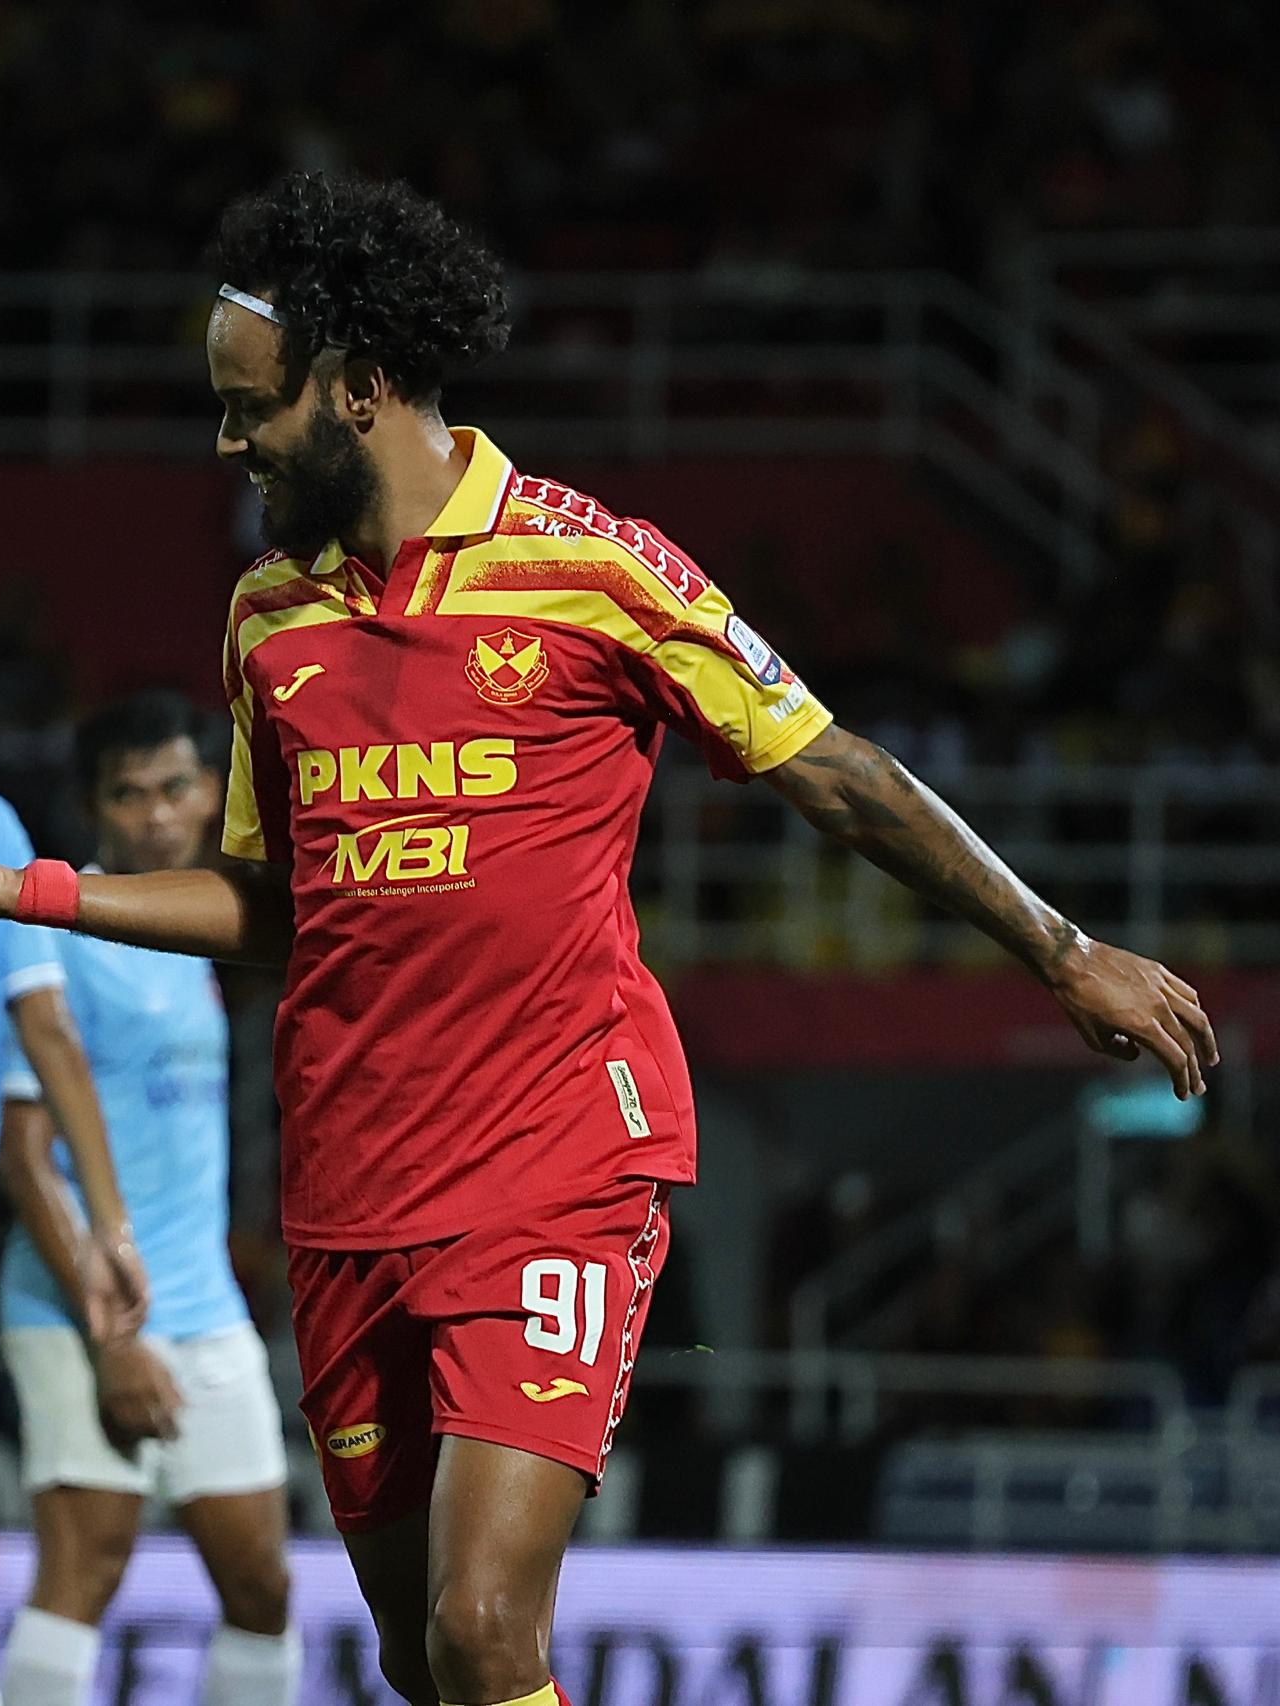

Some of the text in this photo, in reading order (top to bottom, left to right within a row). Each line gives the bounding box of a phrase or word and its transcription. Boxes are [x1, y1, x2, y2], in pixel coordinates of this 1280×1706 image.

[297, 738, 517, 805] PKNS
[332, 824, 469, 883] MBI
[380, 886, 415, 897] Selangor
[417, 878, 476, 894] Incorporated
[521, 1258, 607, 1367] 91
